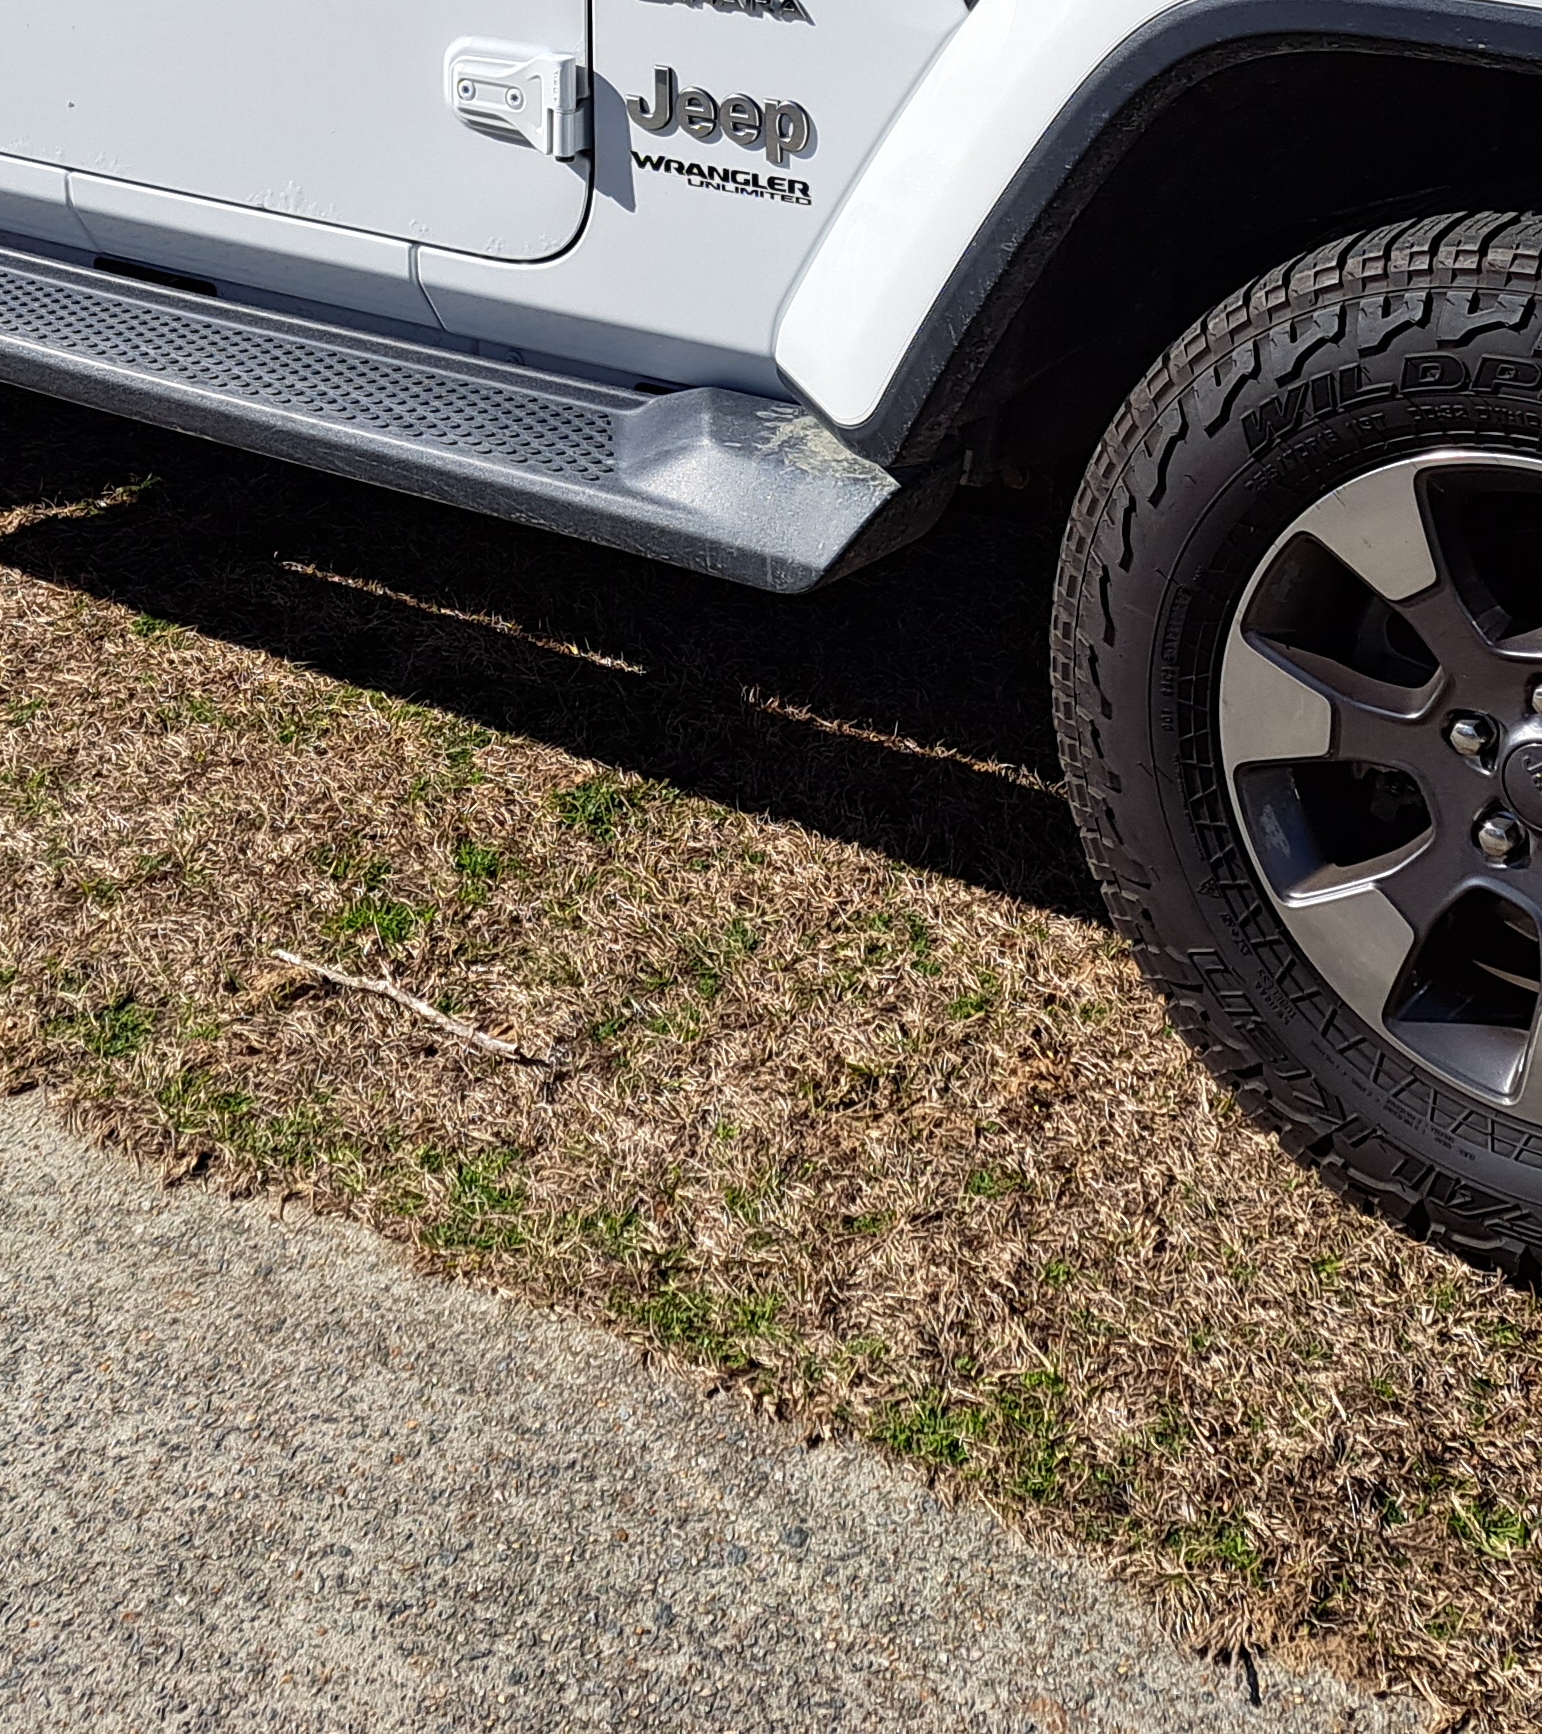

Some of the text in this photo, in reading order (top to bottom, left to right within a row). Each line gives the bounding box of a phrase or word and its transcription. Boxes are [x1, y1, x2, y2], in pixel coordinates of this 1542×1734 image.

[625, 64, 812, 164] Jeep
[630, 150, 811, 198] WRANGLER
[687, 177, 812, 206] UNLIMITED
